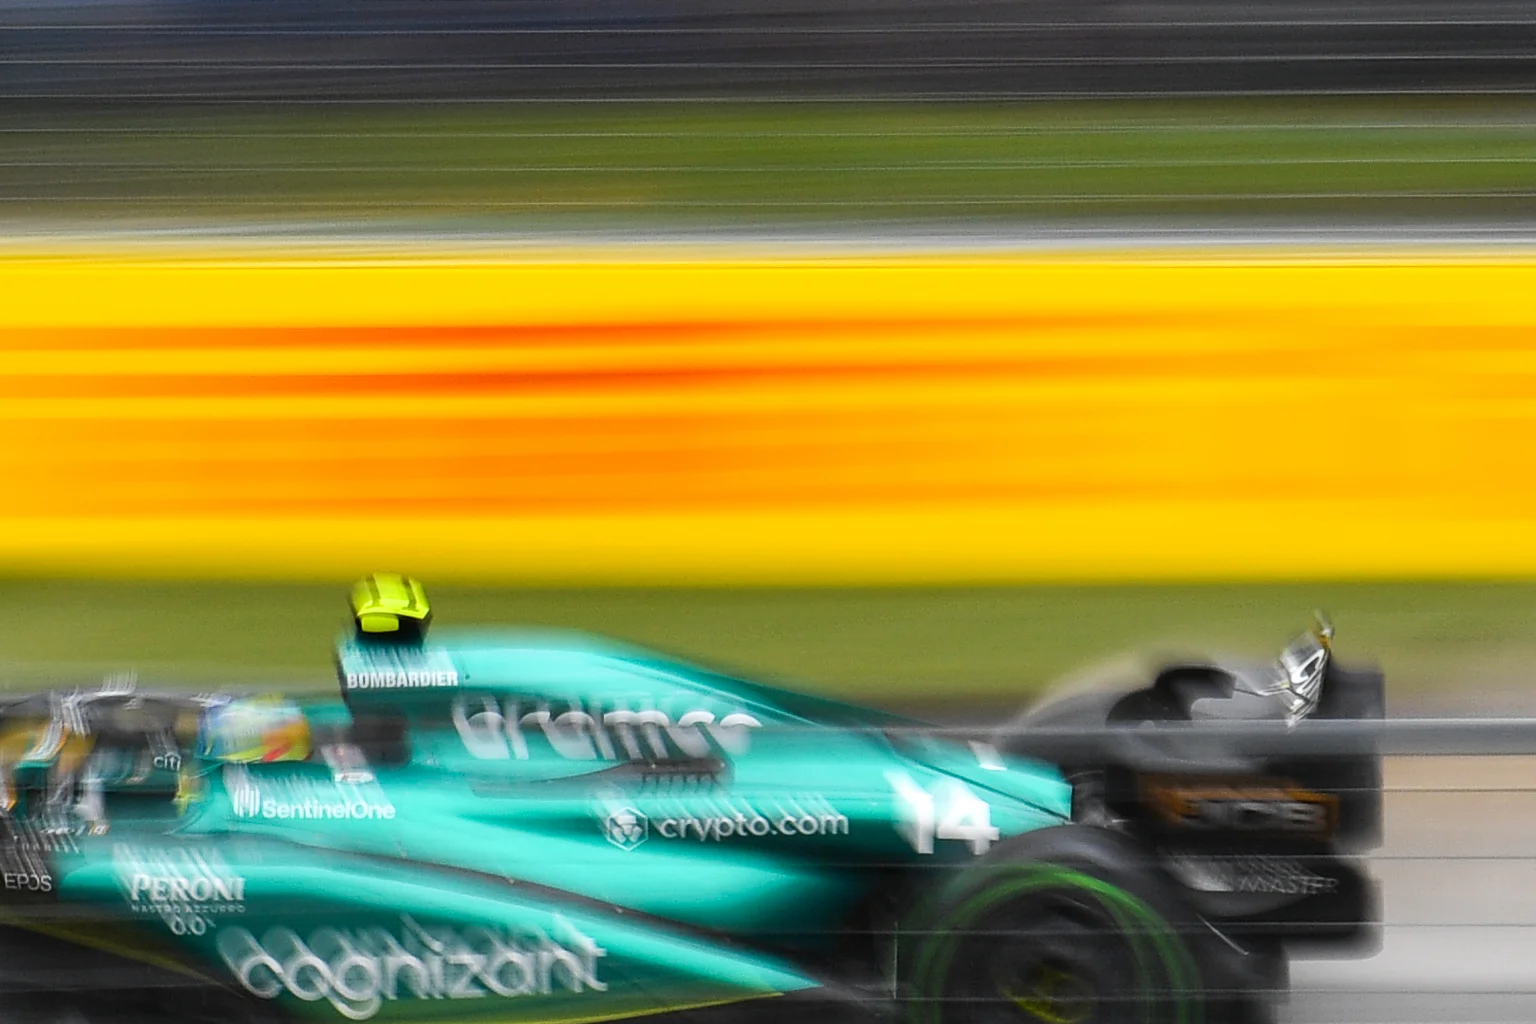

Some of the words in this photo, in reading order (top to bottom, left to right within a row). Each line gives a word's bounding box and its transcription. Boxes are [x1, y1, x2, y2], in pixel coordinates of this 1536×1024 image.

[347, 671, 458, 689] BOMBARDIER
[262, 801, 396, 819] SentinelOne
[896, 776, 999, 855] 14
[659, 812, 849, 842] crypto.com
[4, 873, 52, 892] EPOS
[131, 874, 246, 901] PERONI
[230, 930, 607, 1020] cognizant
